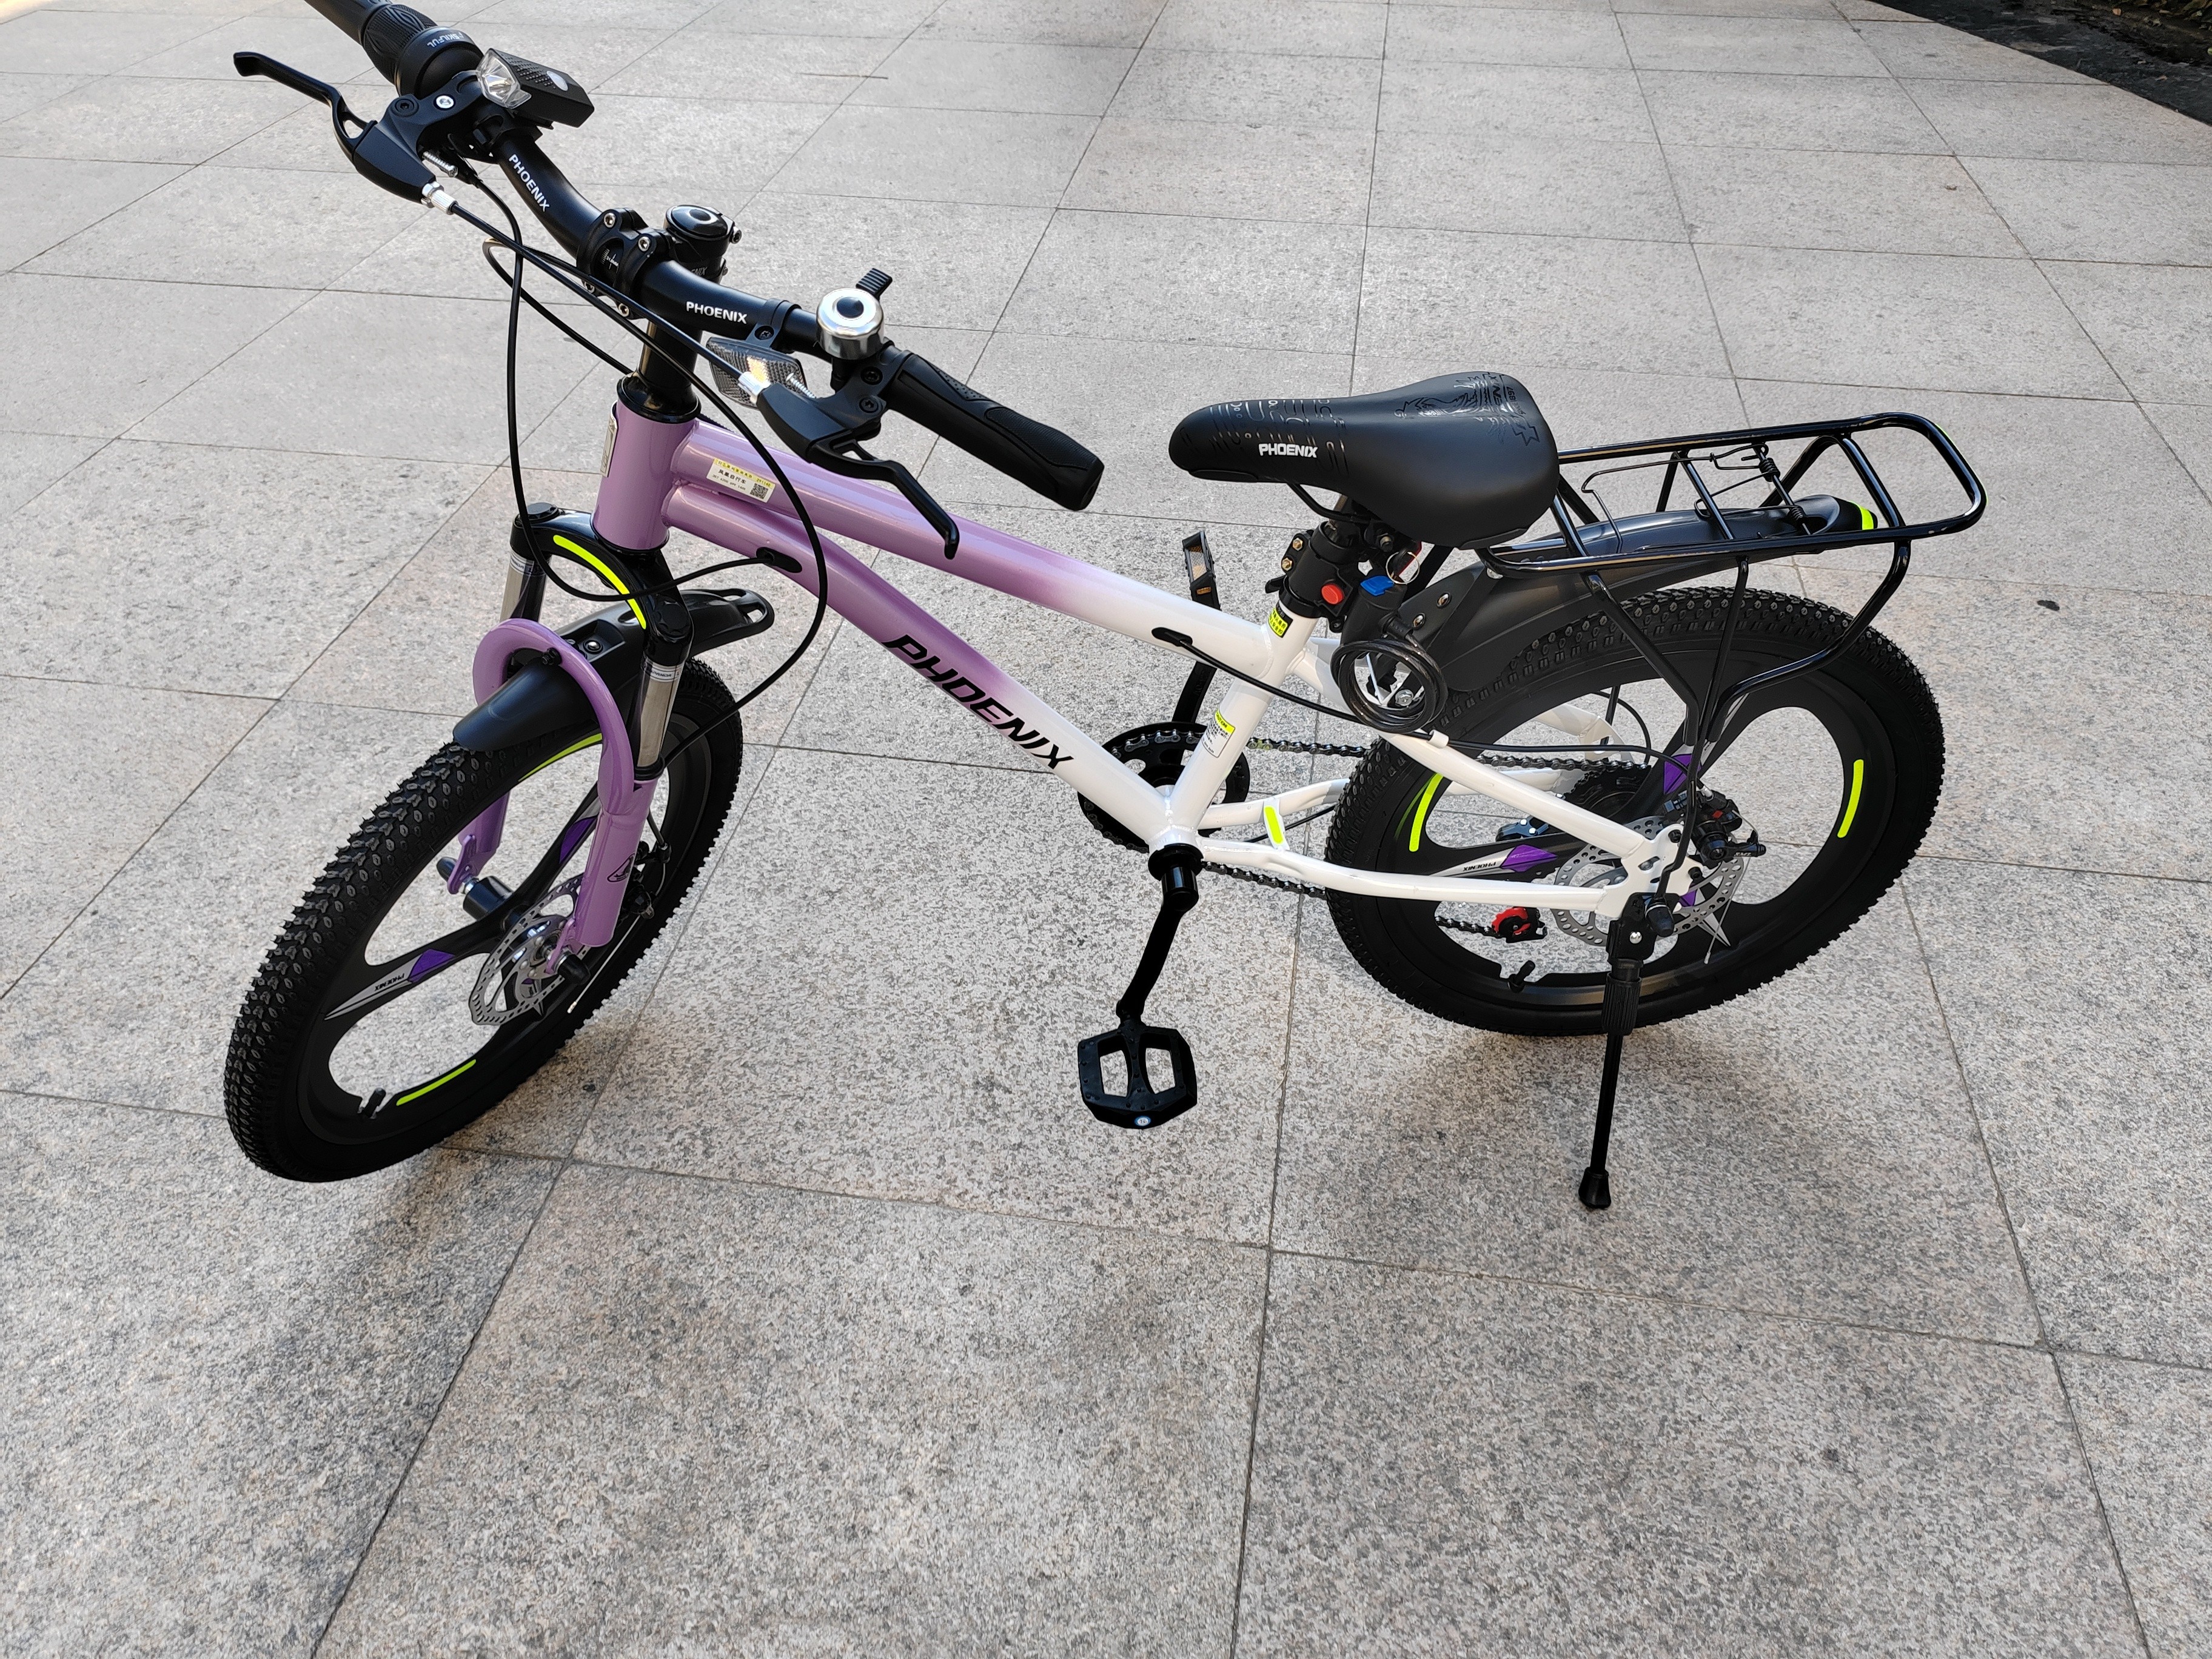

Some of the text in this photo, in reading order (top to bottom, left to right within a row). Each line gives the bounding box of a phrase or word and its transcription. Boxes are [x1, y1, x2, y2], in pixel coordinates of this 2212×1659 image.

[508, 153, 550, 212] PHOENIX
[686, 301, 748, 324] PHOENIX
[1258, 443, 1318, 458] PHOENIX
[880, 634, 1074, 769] PHOENIX
